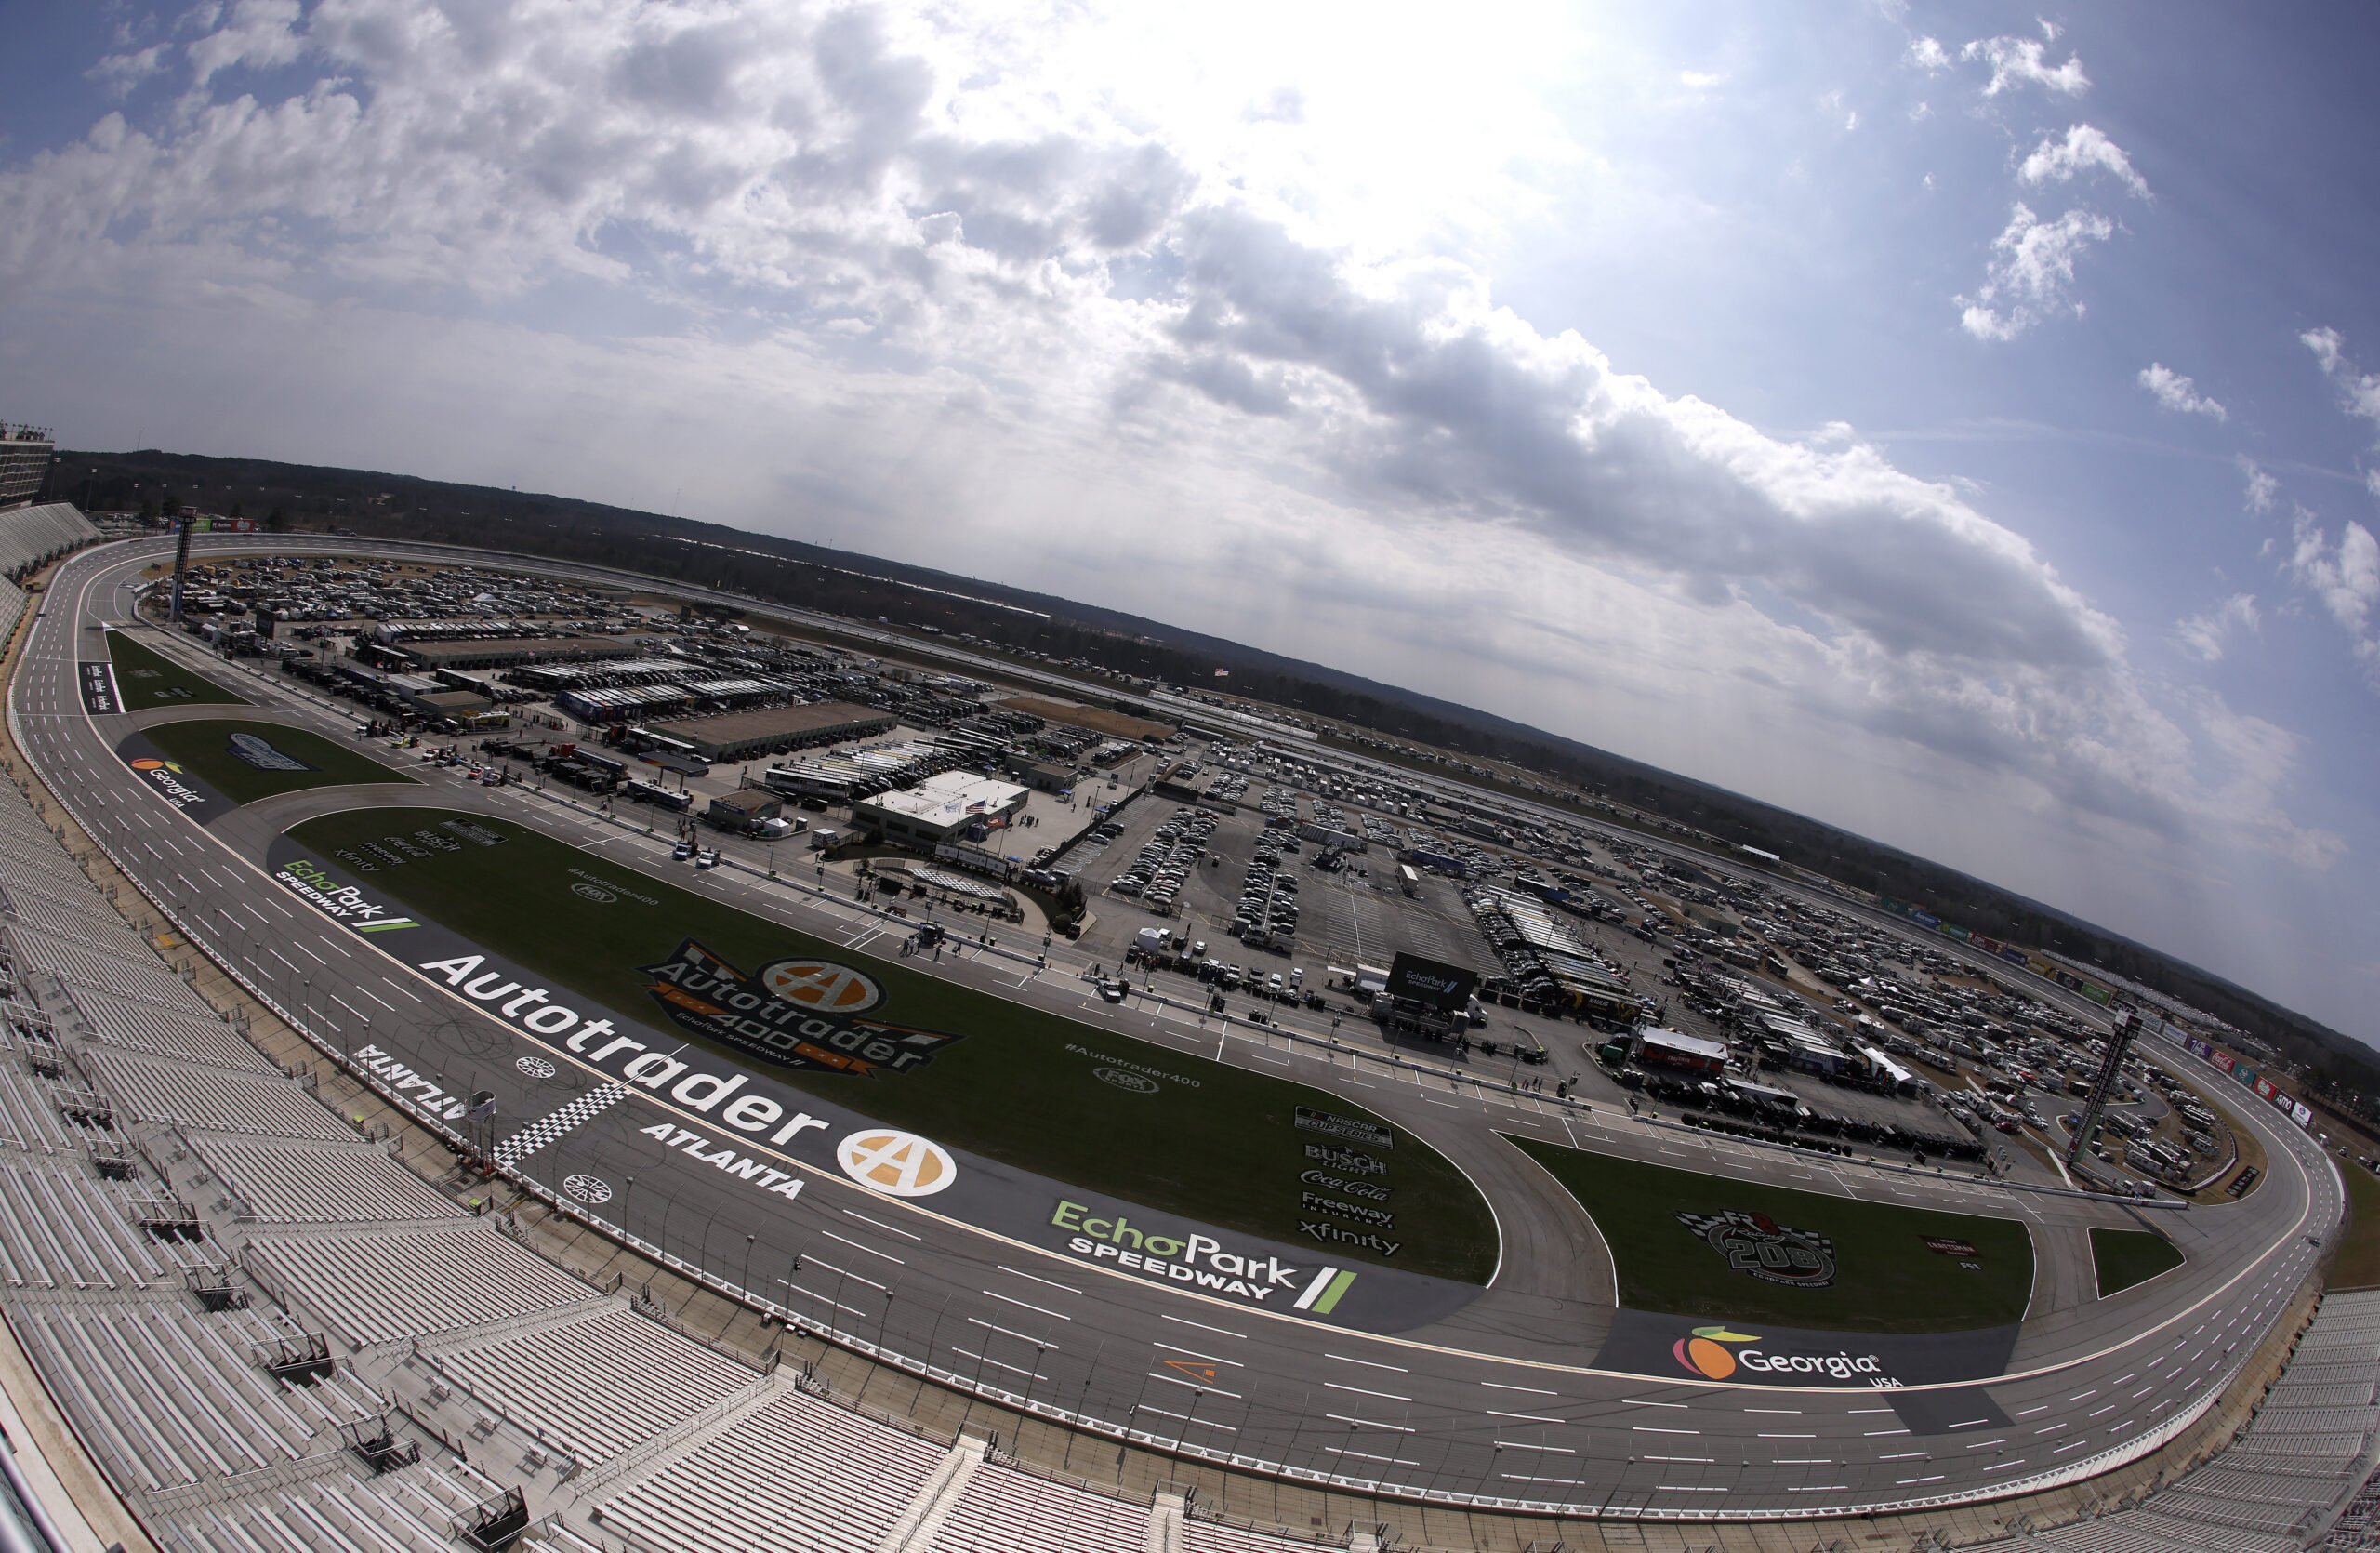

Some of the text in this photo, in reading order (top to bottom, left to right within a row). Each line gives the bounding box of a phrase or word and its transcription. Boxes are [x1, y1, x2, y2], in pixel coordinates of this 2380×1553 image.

[169, 797, 186, 808] USA
[364, 842, 407, 865] Freeway
[414, 830, 462, 852] BUSCH
[334, 848, 381, 872] xfinity
[276, 870, 353, 918] SPEEDWAY
[284, 859, 384, 920] EchoPark
[567, 868, 659, 907] #Autotrader400
[1405, 970, 1448, 989] EchoPark
[1408, 979, 1441, 991] SPEEDWAY
[649, 962, 923, 1069] Autotrader
[676, 1012, 791, 1062] EchoPark SPEEDWAY
[707, 1013, 801, 1051] 400
[420, 954, 830, 1146] Autotrader
[1064, 1042, 1201, 1089] #Autotrader400
[352, 1043, 467, 1120] ATLANTA
[1105, 1069, 1147, 1088] FOX
[1327, 1115, 1377, 1133] NASCAR
[640, 1122, 806, 1201] ATLANTA
[1304, 1145, 1387, 1175] BUSCH
[1302, 1191, 1394, 1224] Freeway
[1302, 1203, 1394, 1229] INSURANCE
[1051, 1200, 1298, 1290] EchoPark
[1299, 1220, 1400, 1256] xfinity
[1726, 1238, 1821, 1269] 208
[1926, 1241, 1976, 1254] CRAFTSMAN
[1068, 1237, 1275, 1300] SPEEDWAY
[1961, 1262, 1982, 1270] FS1
[1869, 1376, 1904, 1387] USA
